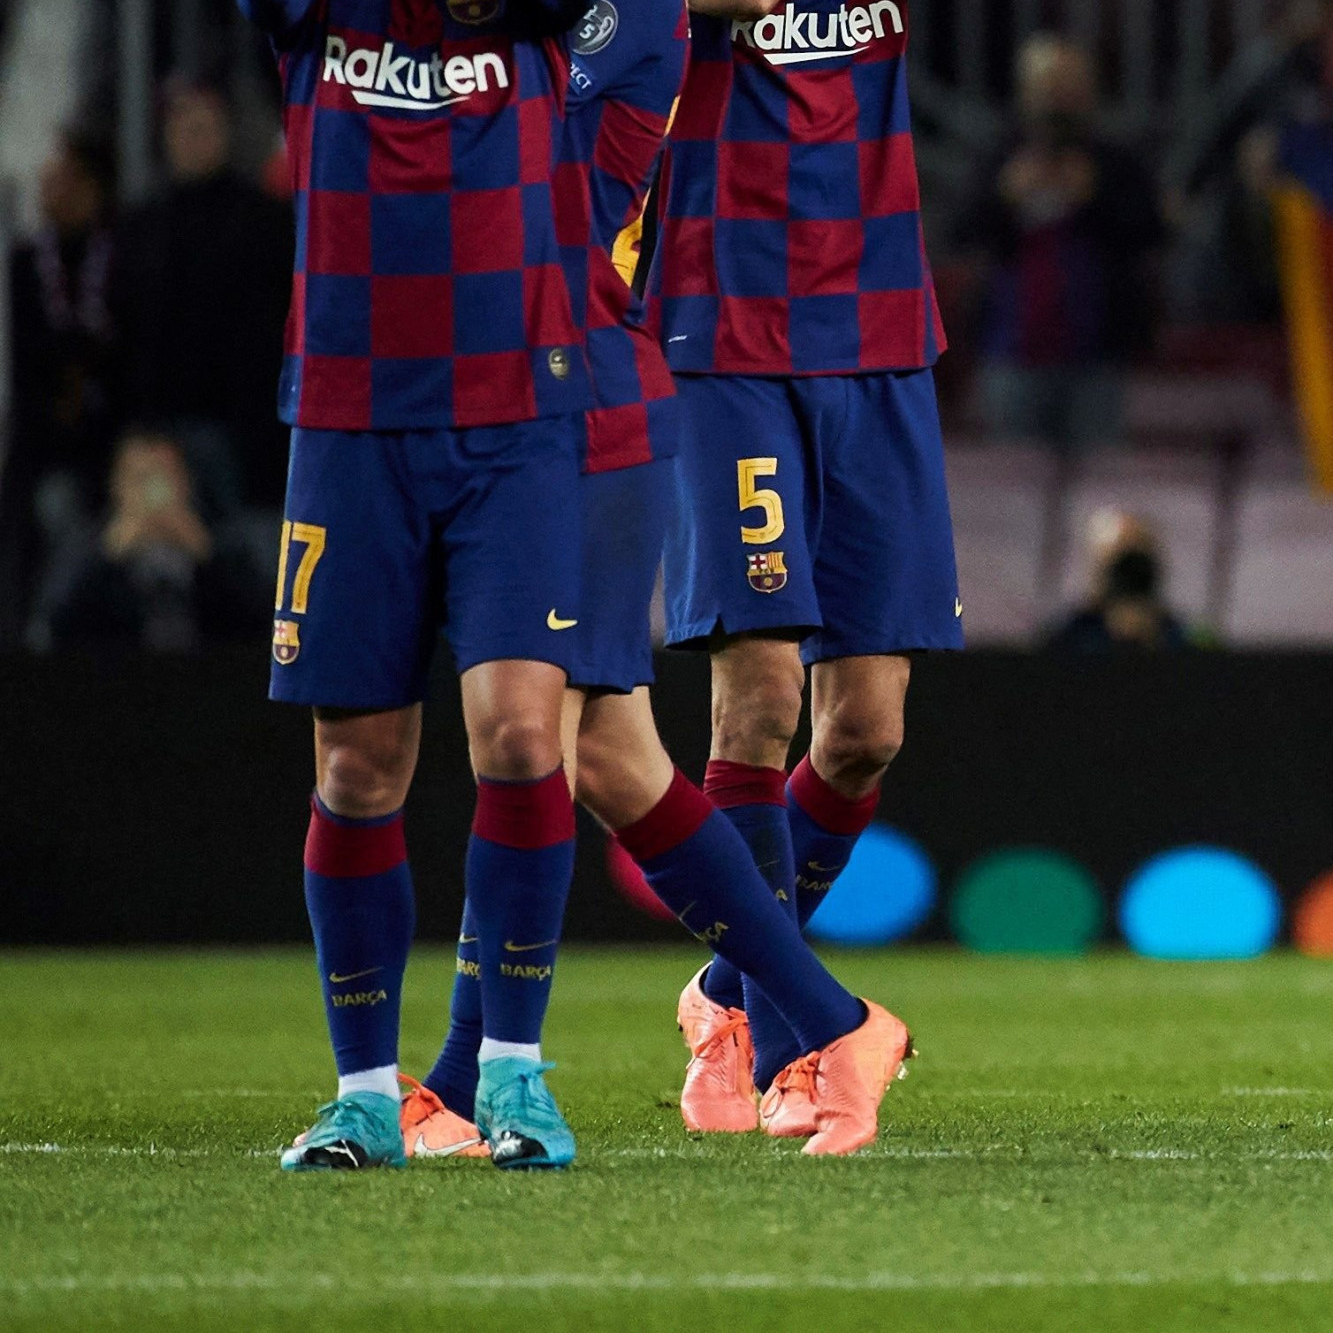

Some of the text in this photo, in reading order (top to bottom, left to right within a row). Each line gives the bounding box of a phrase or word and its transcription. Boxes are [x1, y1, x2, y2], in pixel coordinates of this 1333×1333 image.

[579, 23, 596, 39] 5
[323, 35, 509, 100] Rakuten
[737, 457, 785, 544] 5
[275, 519, 327, 615] 17
[501, 963, 551, 981] BARÇA
[331, 989, 387, 1007] BARÇA
